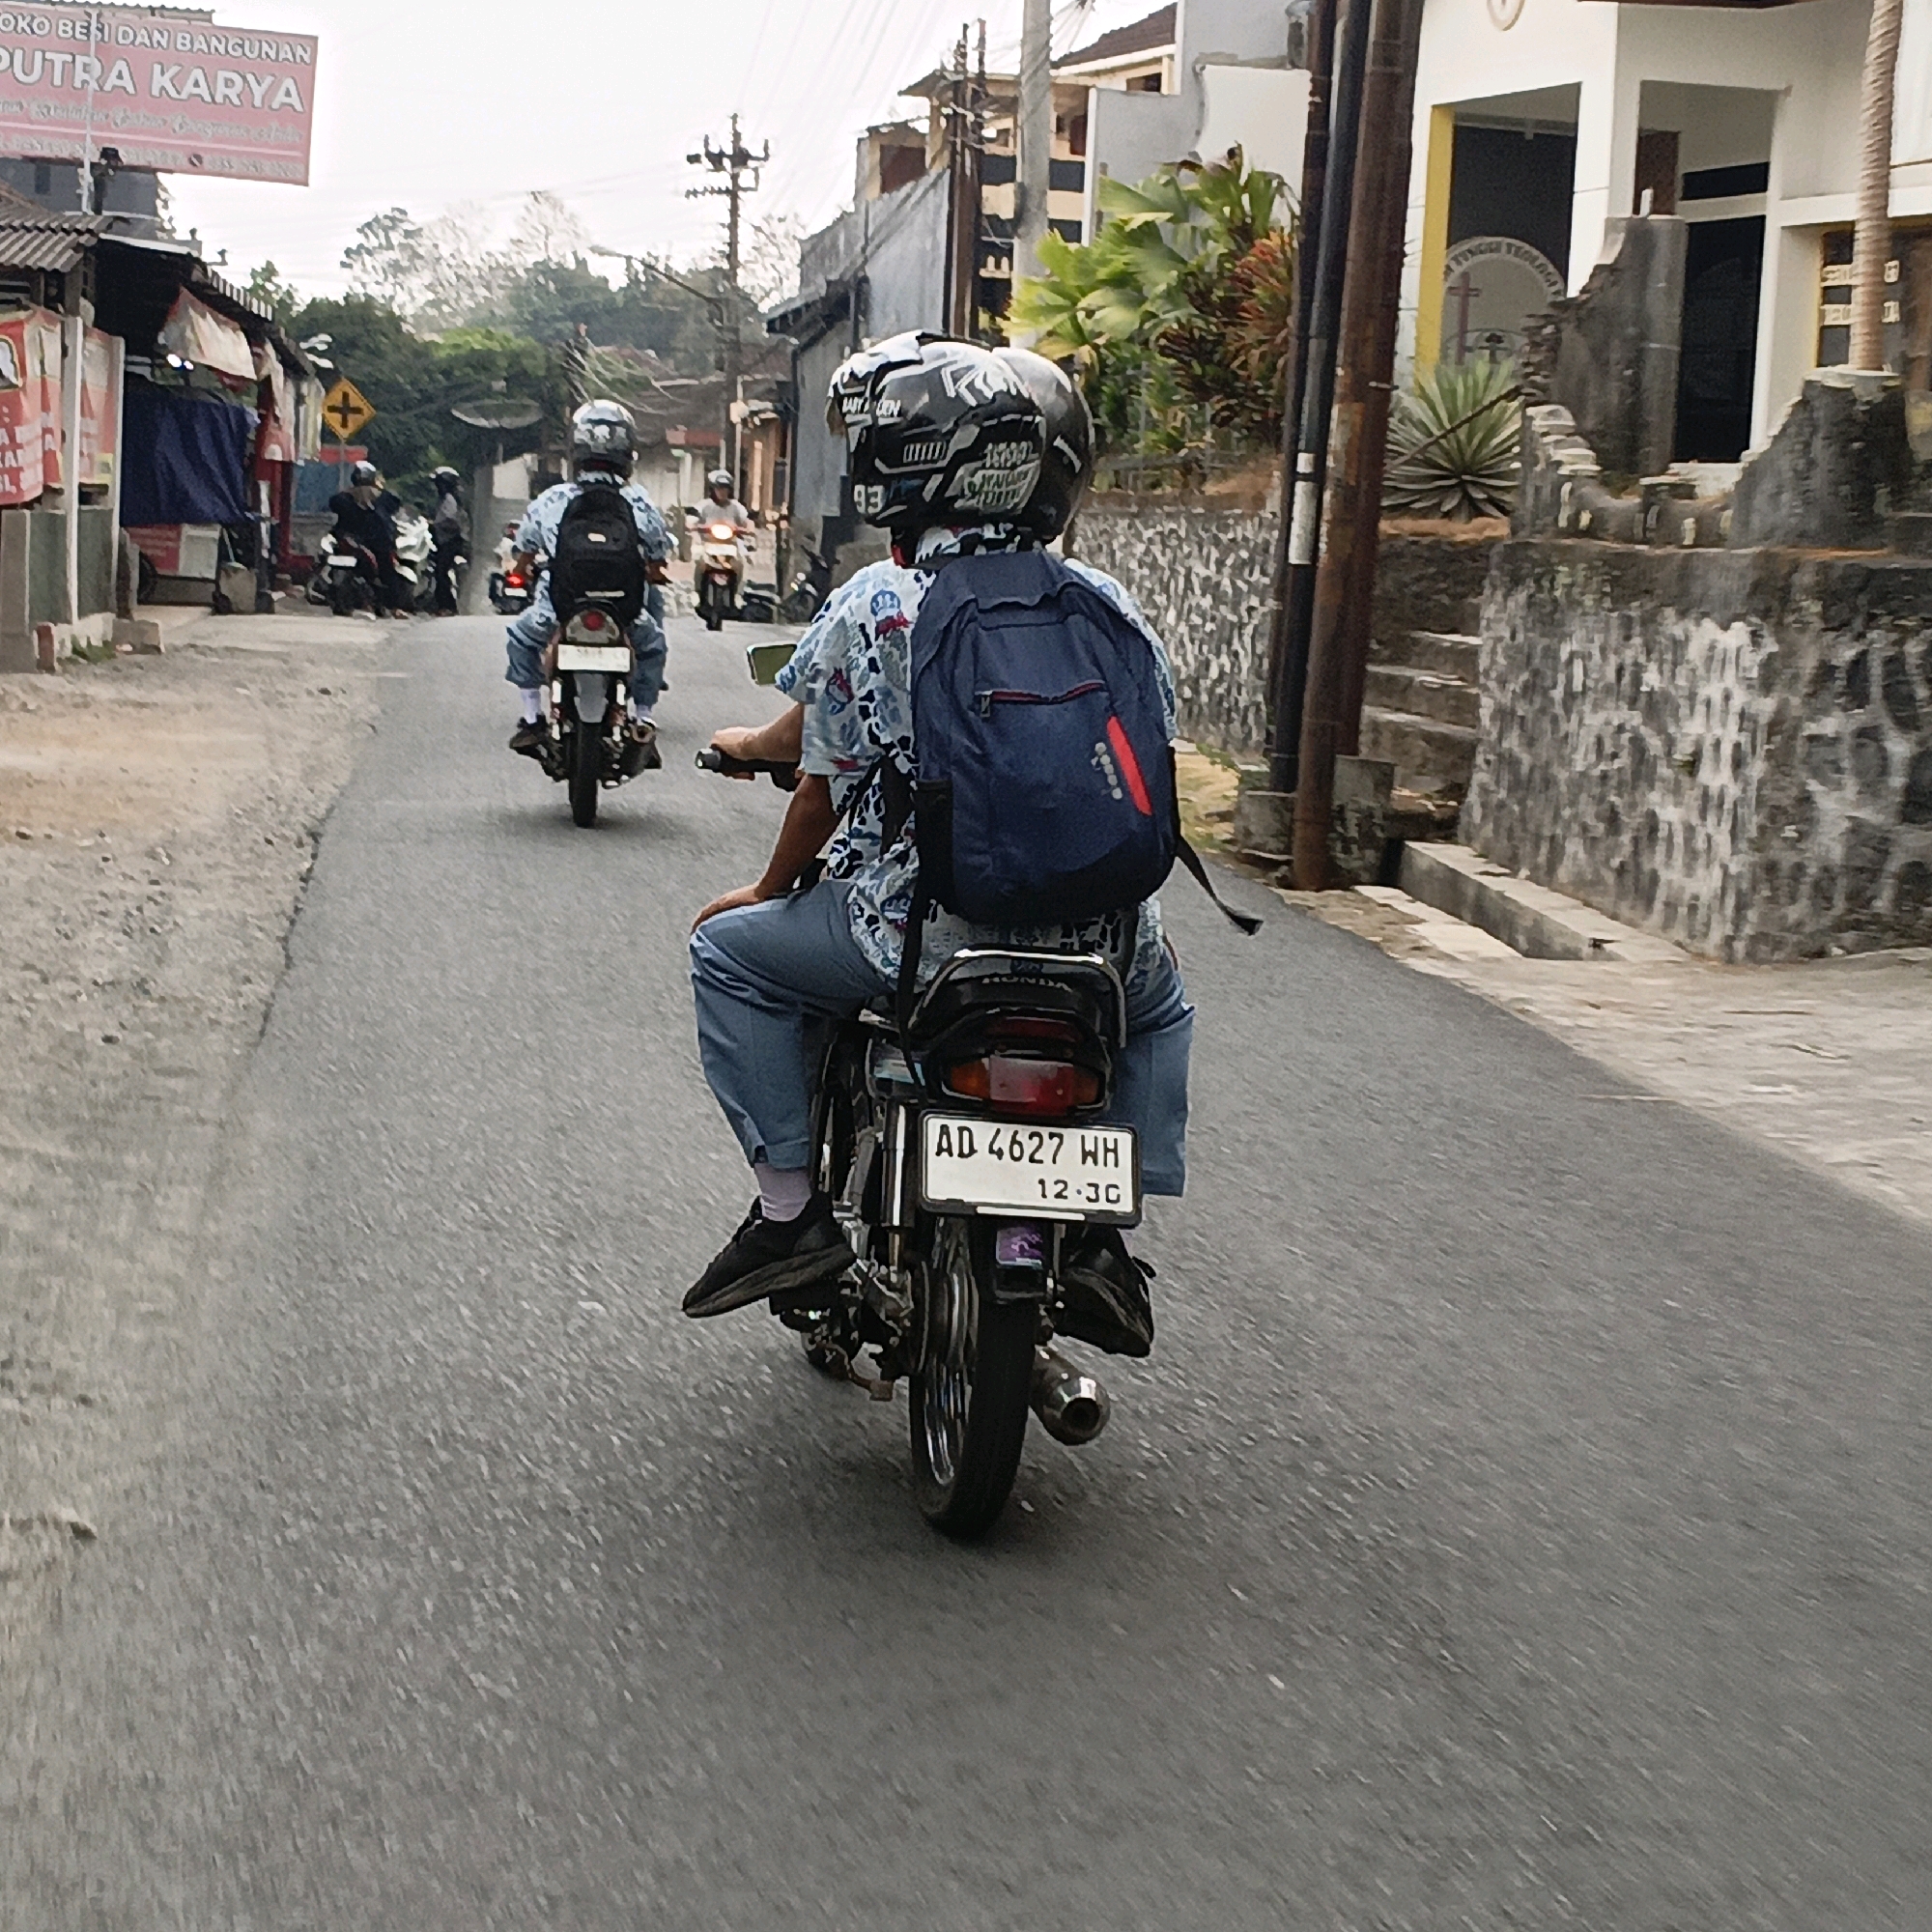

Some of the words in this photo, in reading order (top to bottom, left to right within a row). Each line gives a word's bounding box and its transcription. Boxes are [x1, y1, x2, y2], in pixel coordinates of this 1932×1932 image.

[0, 13, 52, 38] OKO
[57, 18, 111, 43] BESI
[116, 24, 170, 49] DAN
[175, 31, 312, 65] BANGUNAN
[151, 61, 305, 113] KARYA
[854, 484, 884, 515] 93
[935, 1123, 979, 1158] AD
[987, 1127, 1065, 1165] 4627
[1081, 1134, 1119, 1168] WH
